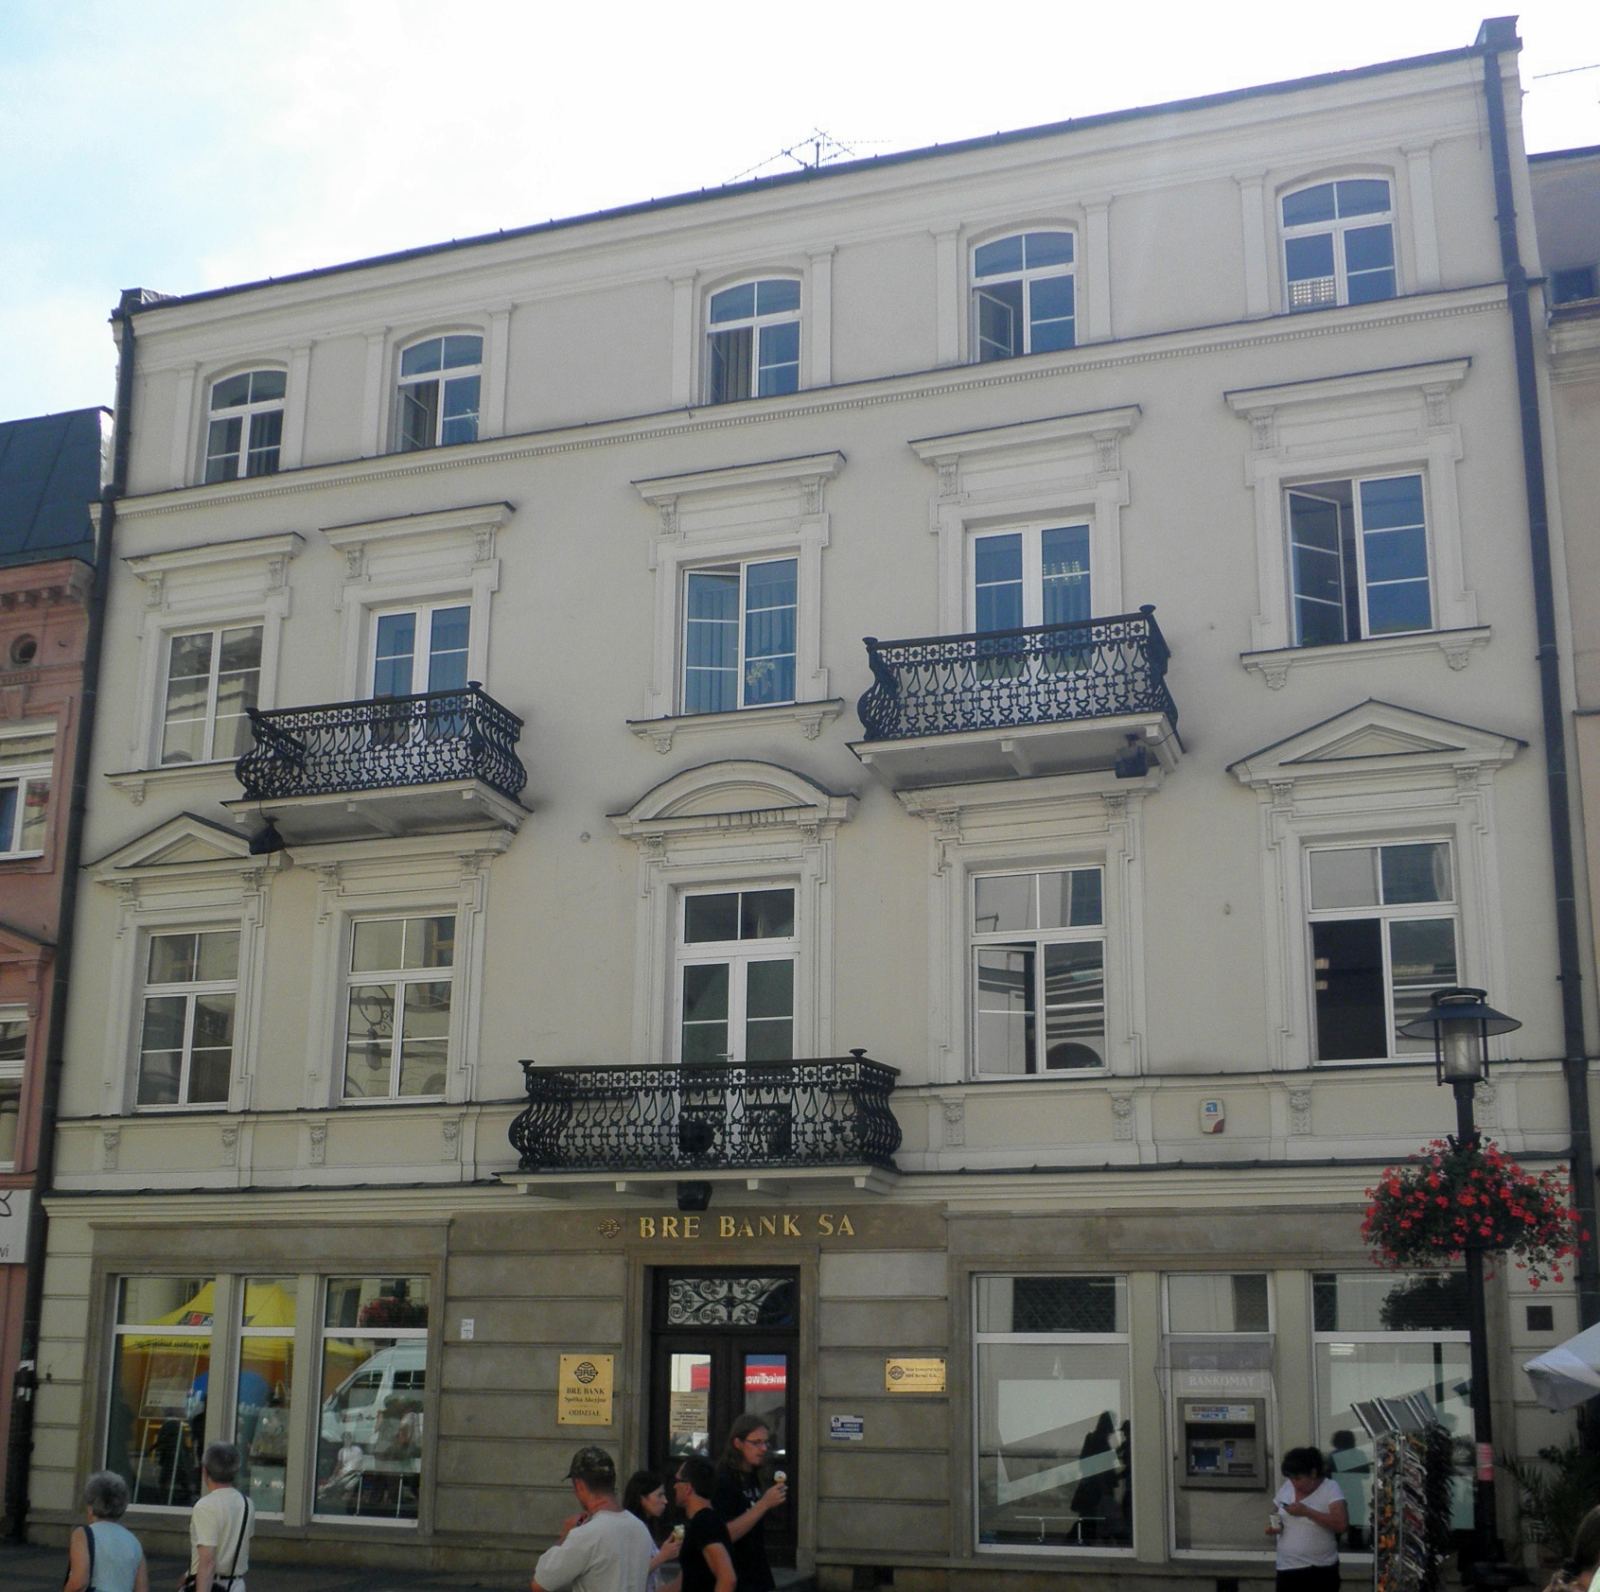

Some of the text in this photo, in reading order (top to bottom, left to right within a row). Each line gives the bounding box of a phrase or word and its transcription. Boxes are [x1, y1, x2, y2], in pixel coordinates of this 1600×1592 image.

[639, 1216, 701, 1239] BRE
[719, 1214, 802, 1238] BANK
[817, 1213, 856, 1237] SA
[1188, 1375, 1256, 1387] BANKOMAT
[584, 1388, 604, 1396] BANK
